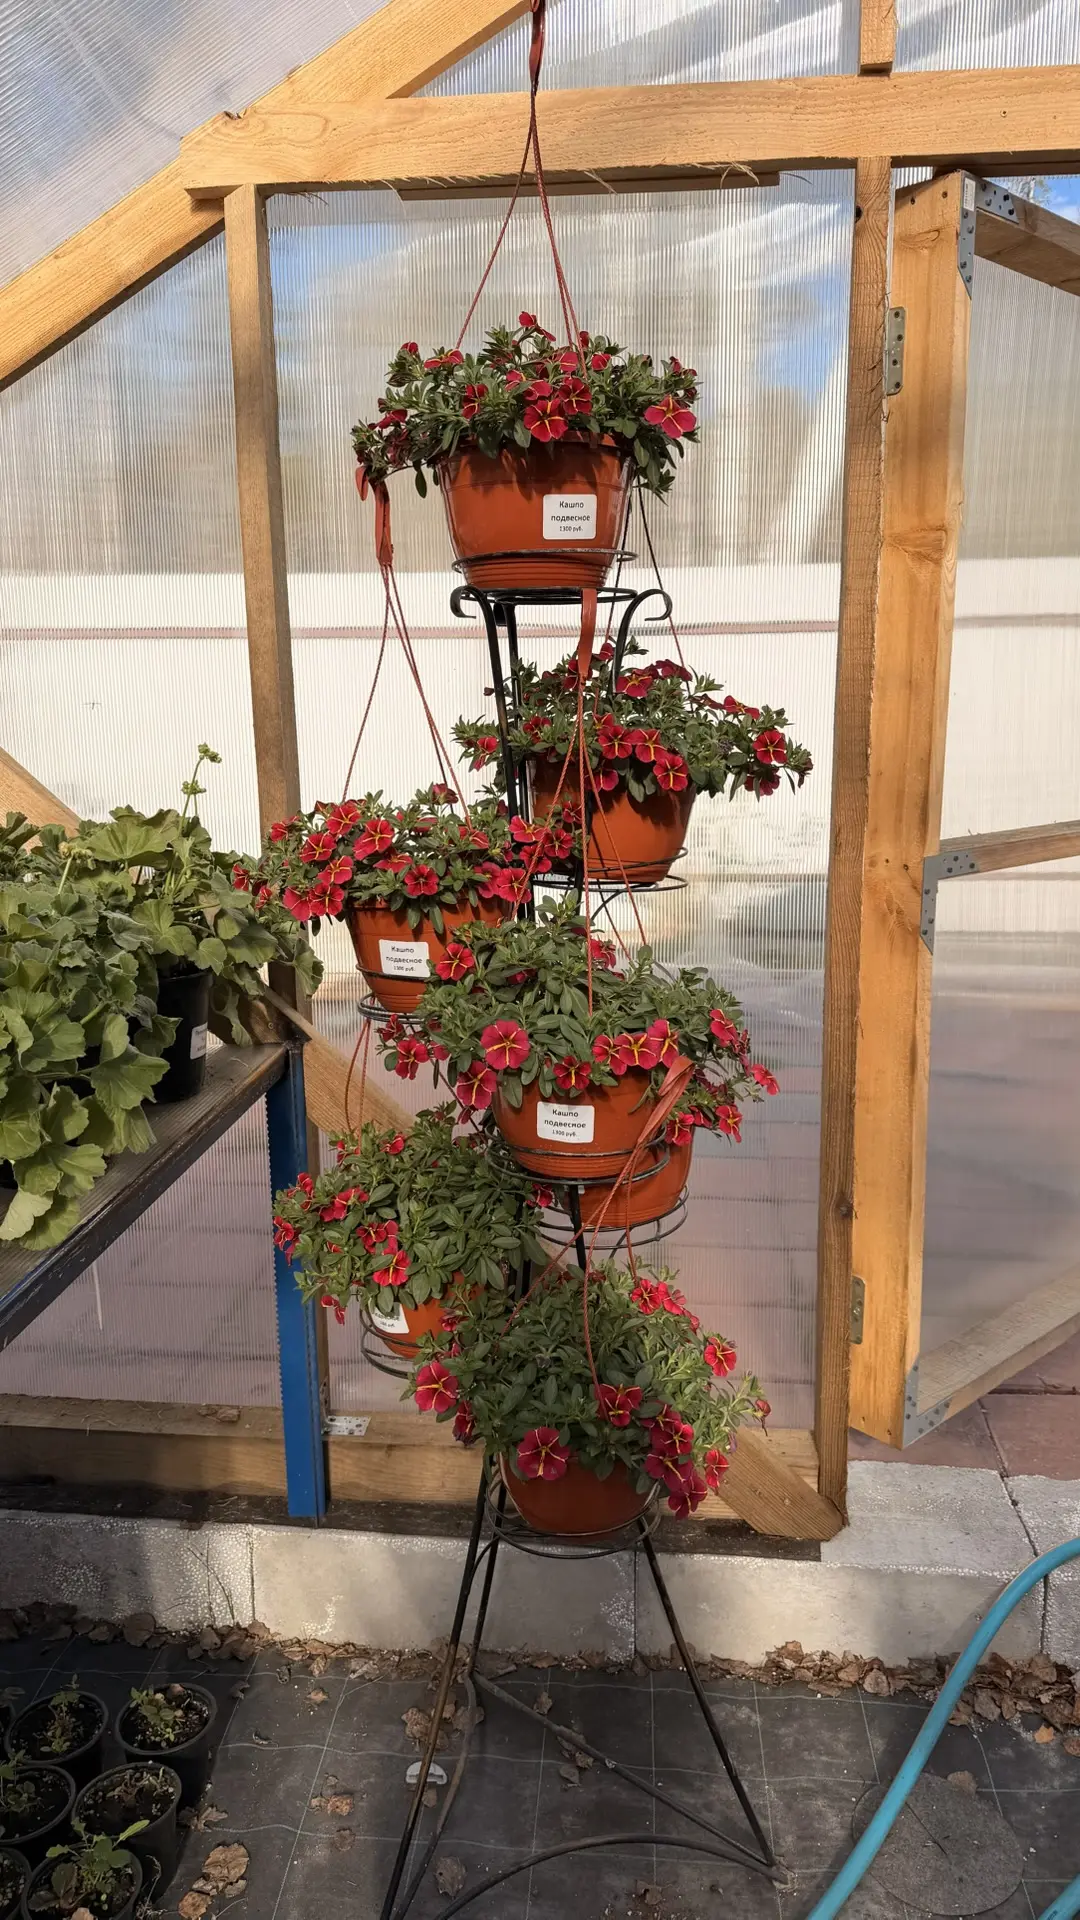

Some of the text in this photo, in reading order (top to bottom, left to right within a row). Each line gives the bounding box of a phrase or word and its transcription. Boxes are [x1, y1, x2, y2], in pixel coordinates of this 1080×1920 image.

[559, 500, 585, 508] Кашпо
[550, 514, 591, 523] подвесное
[552, 1108, 579, 1118] Кашпо
[544, 1119, 587, 1129] подвесное
